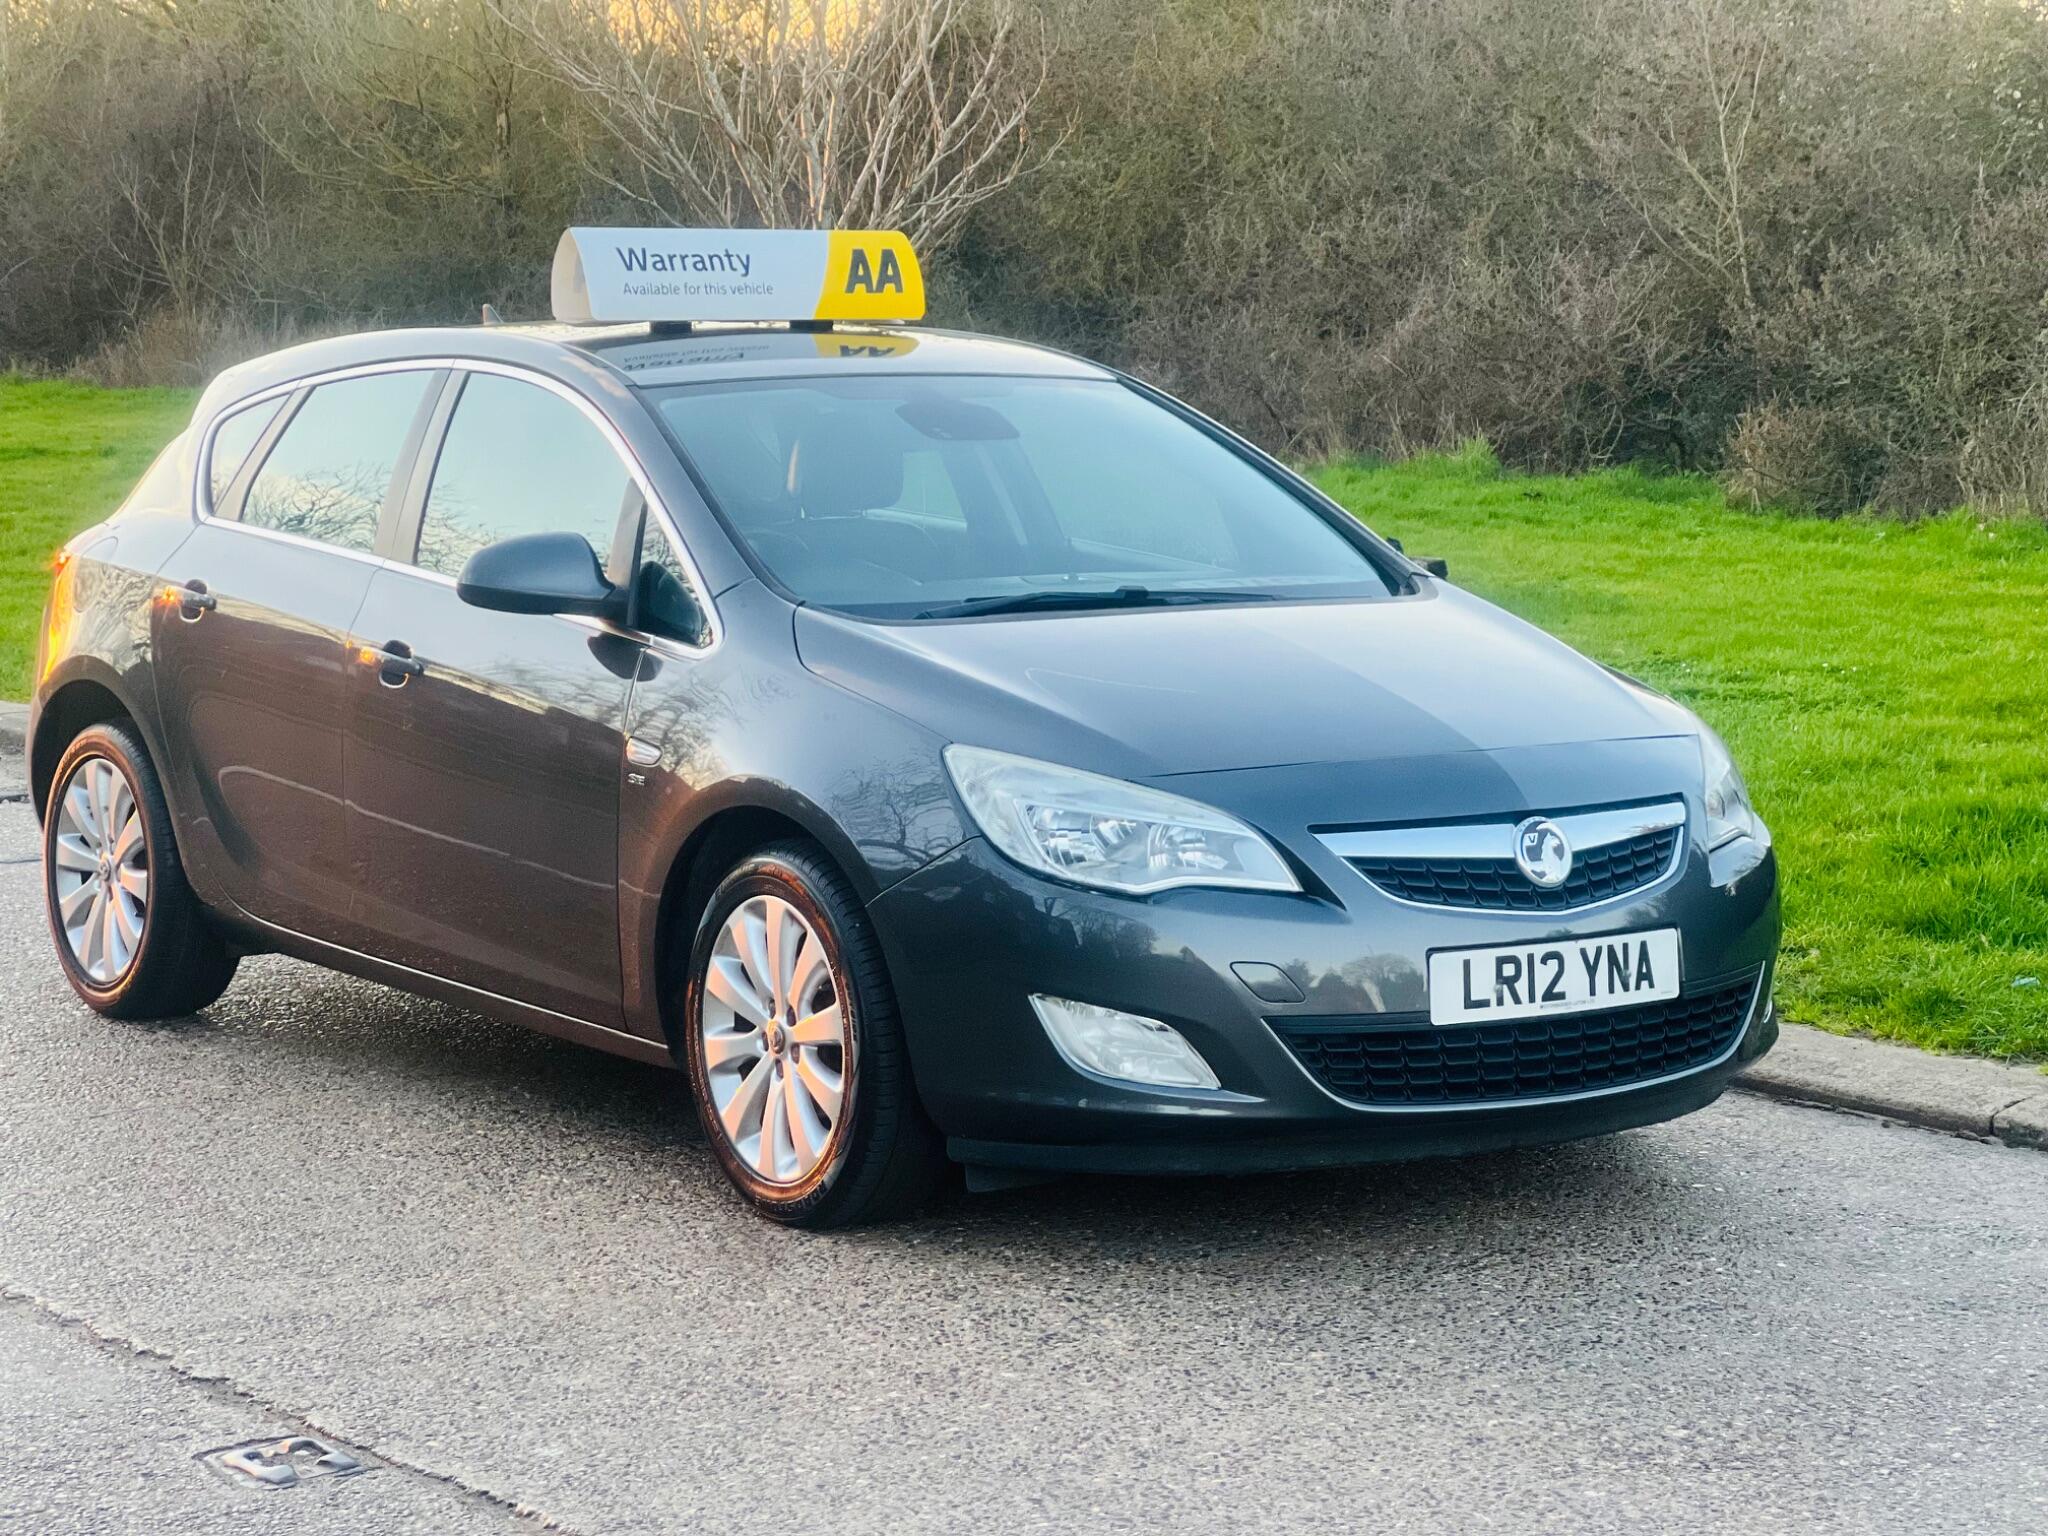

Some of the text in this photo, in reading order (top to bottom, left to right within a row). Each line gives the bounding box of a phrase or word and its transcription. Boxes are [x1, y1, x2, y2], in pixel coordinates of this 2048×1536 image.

[616, 247, 751, 277] Warranty
[845, 248, 904, 294] AA
[623, 280, 774, 296] Available for this vehicle
[1462, 940, 1656, 1010] LR12 YNA
